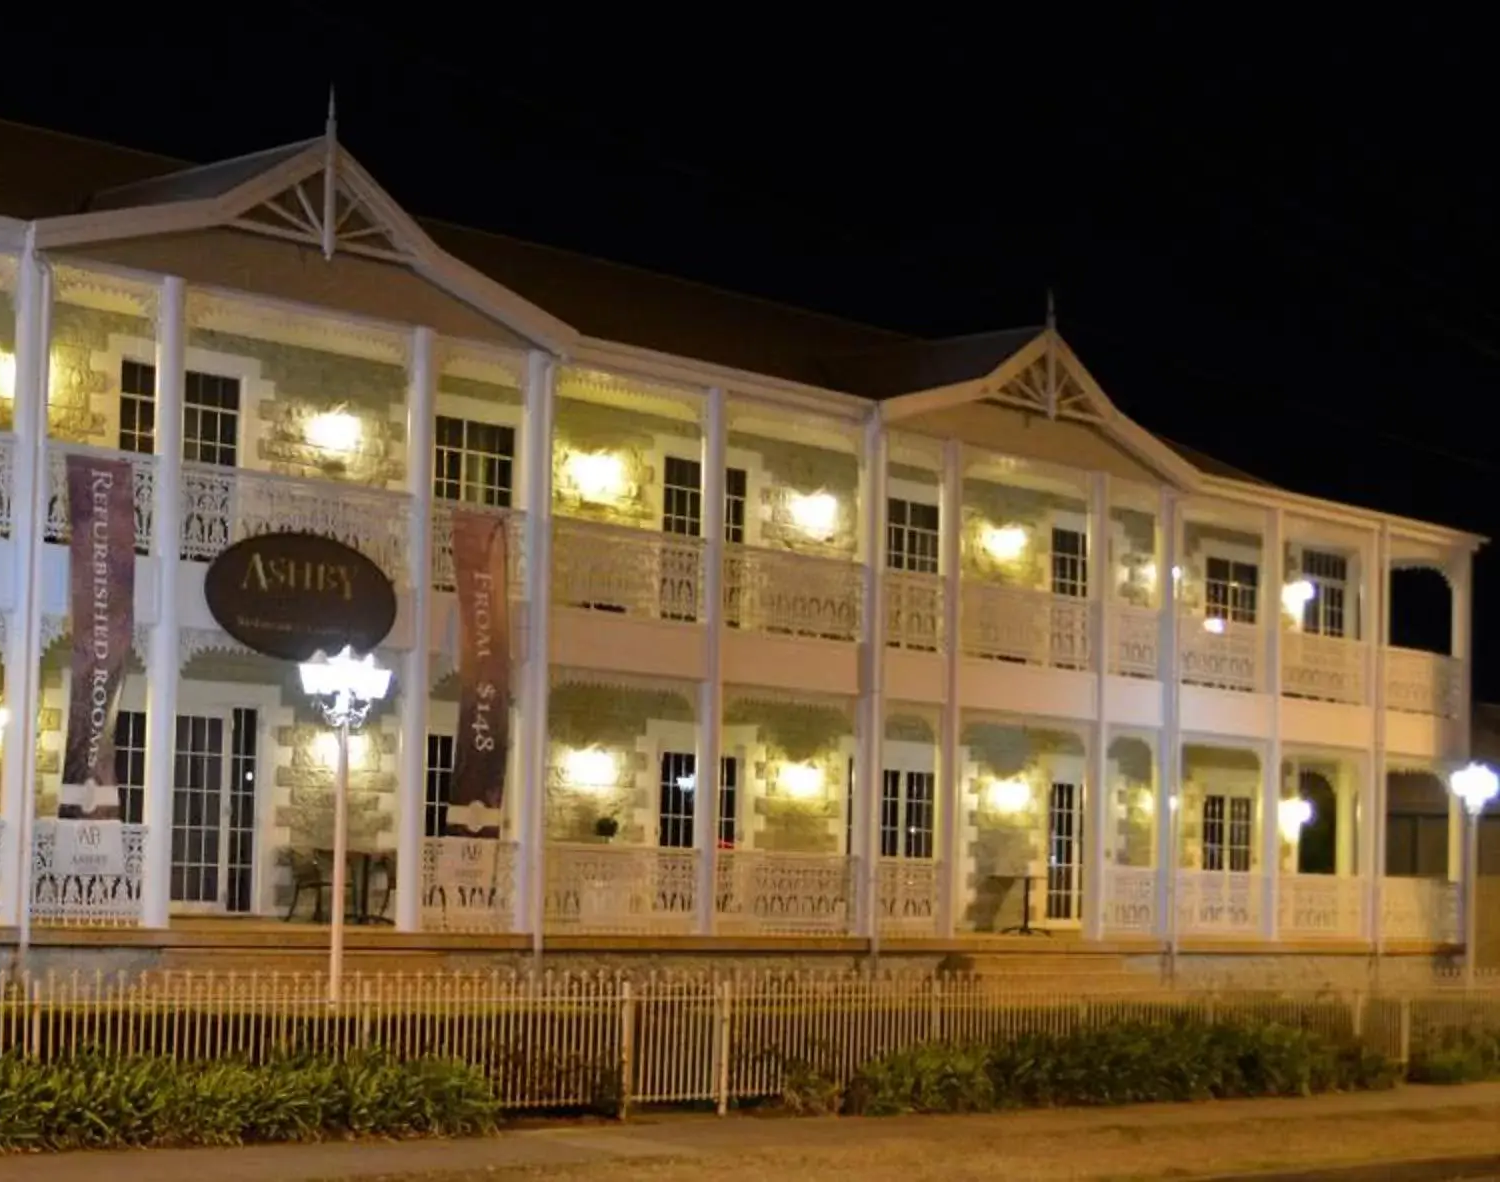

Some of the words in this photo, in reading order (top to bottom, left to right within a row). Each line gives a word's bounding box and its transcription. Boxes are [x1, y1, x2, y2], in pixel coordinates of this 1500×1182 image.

[91, 468, 114, 661] REFURBISHED
[240, 552, 360, 600] ASHBY
[472, 570, 495, 657] FROM
[87, 667, 110, 768] ROOMS
[472, 681, 497, 752] $148
